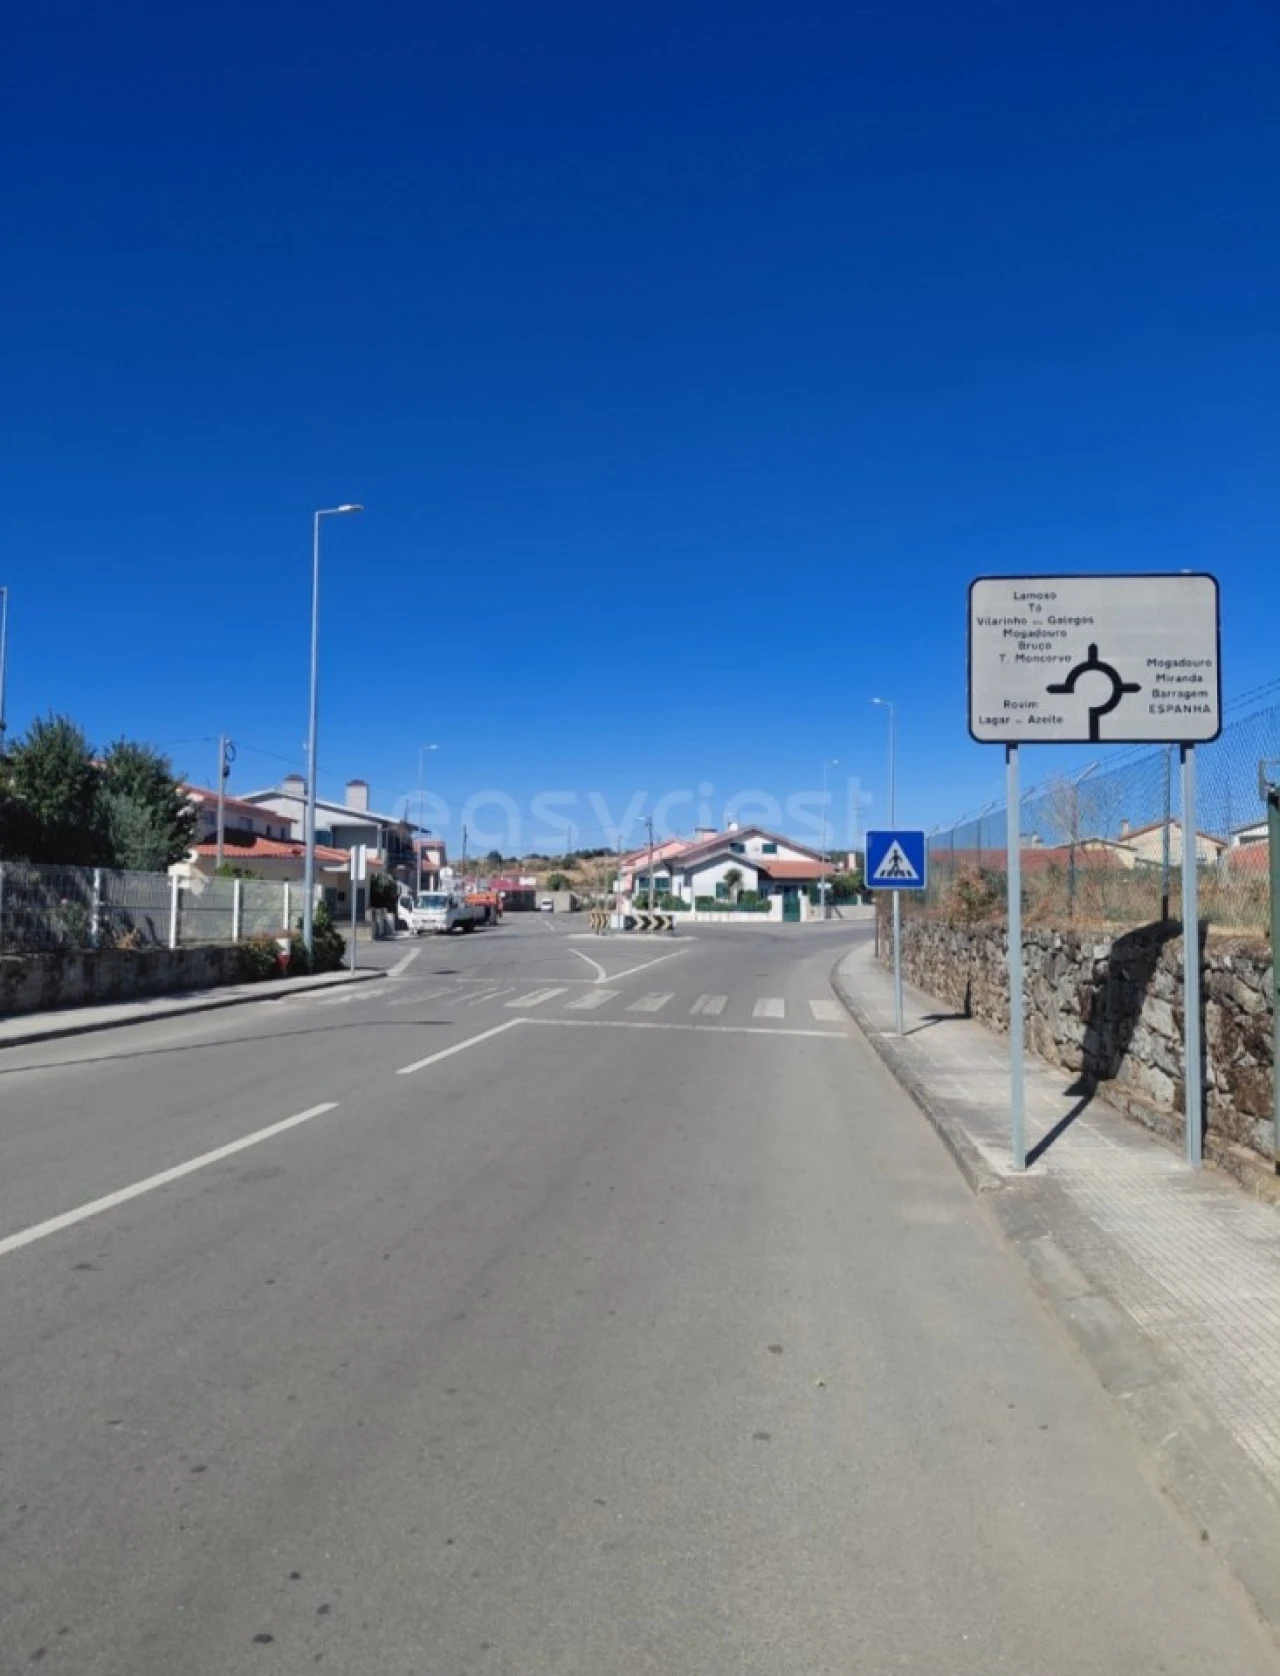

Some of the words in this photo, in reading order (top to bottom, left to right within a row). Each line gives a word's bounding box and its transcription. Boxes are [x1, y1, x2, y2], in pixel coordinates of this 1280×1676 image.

[1013, 591, 1057, 601] Lamoso
[977, 617, 1028, 626] Vilarinho
[1047, 615, 1094, 626] Galegos
[1003, 628, 1067, 639] Mogadouro
[1018, 640, 1052, 652] Bruço
[1016, 653, 1072, 663] Moncorvo
[1147, 658, 1212, 669] Mogadouro
[1156, 673, 1203, 682] Miranda
[1152, 688, 1208, 700] Barragem
[1149, 704, 1211, 714] ESPANHA
[979, 715, 1010, 726] Lagar
[1028, 713, 1064, 724] Azeite
